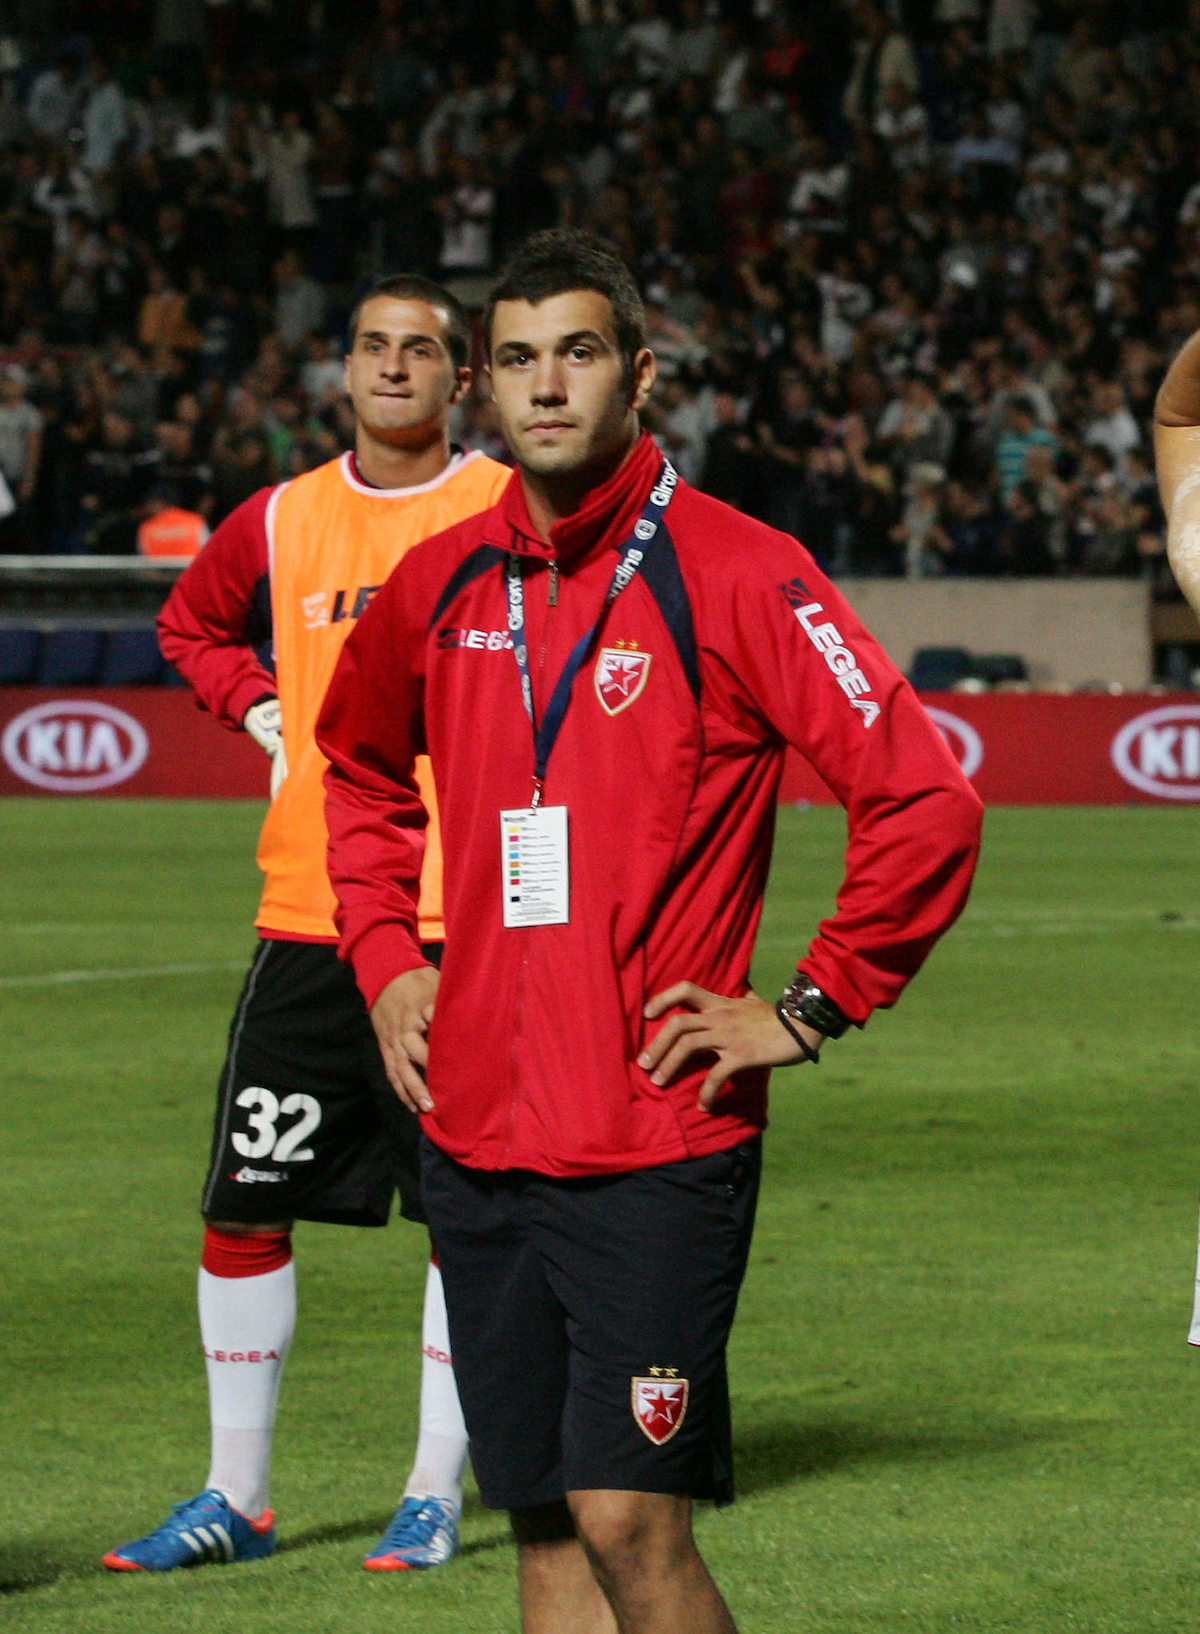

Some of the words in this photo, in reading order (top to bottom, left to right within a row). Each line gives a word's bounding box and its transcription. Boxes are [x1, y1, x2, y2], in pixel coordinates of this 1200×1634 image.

[794, 602, 881, 729] LEGEA
[27, 720, 122, 771] KIA
[231, 1086, 323, 1163] 32
[202, 1345, 280, 1363] LEGEA
